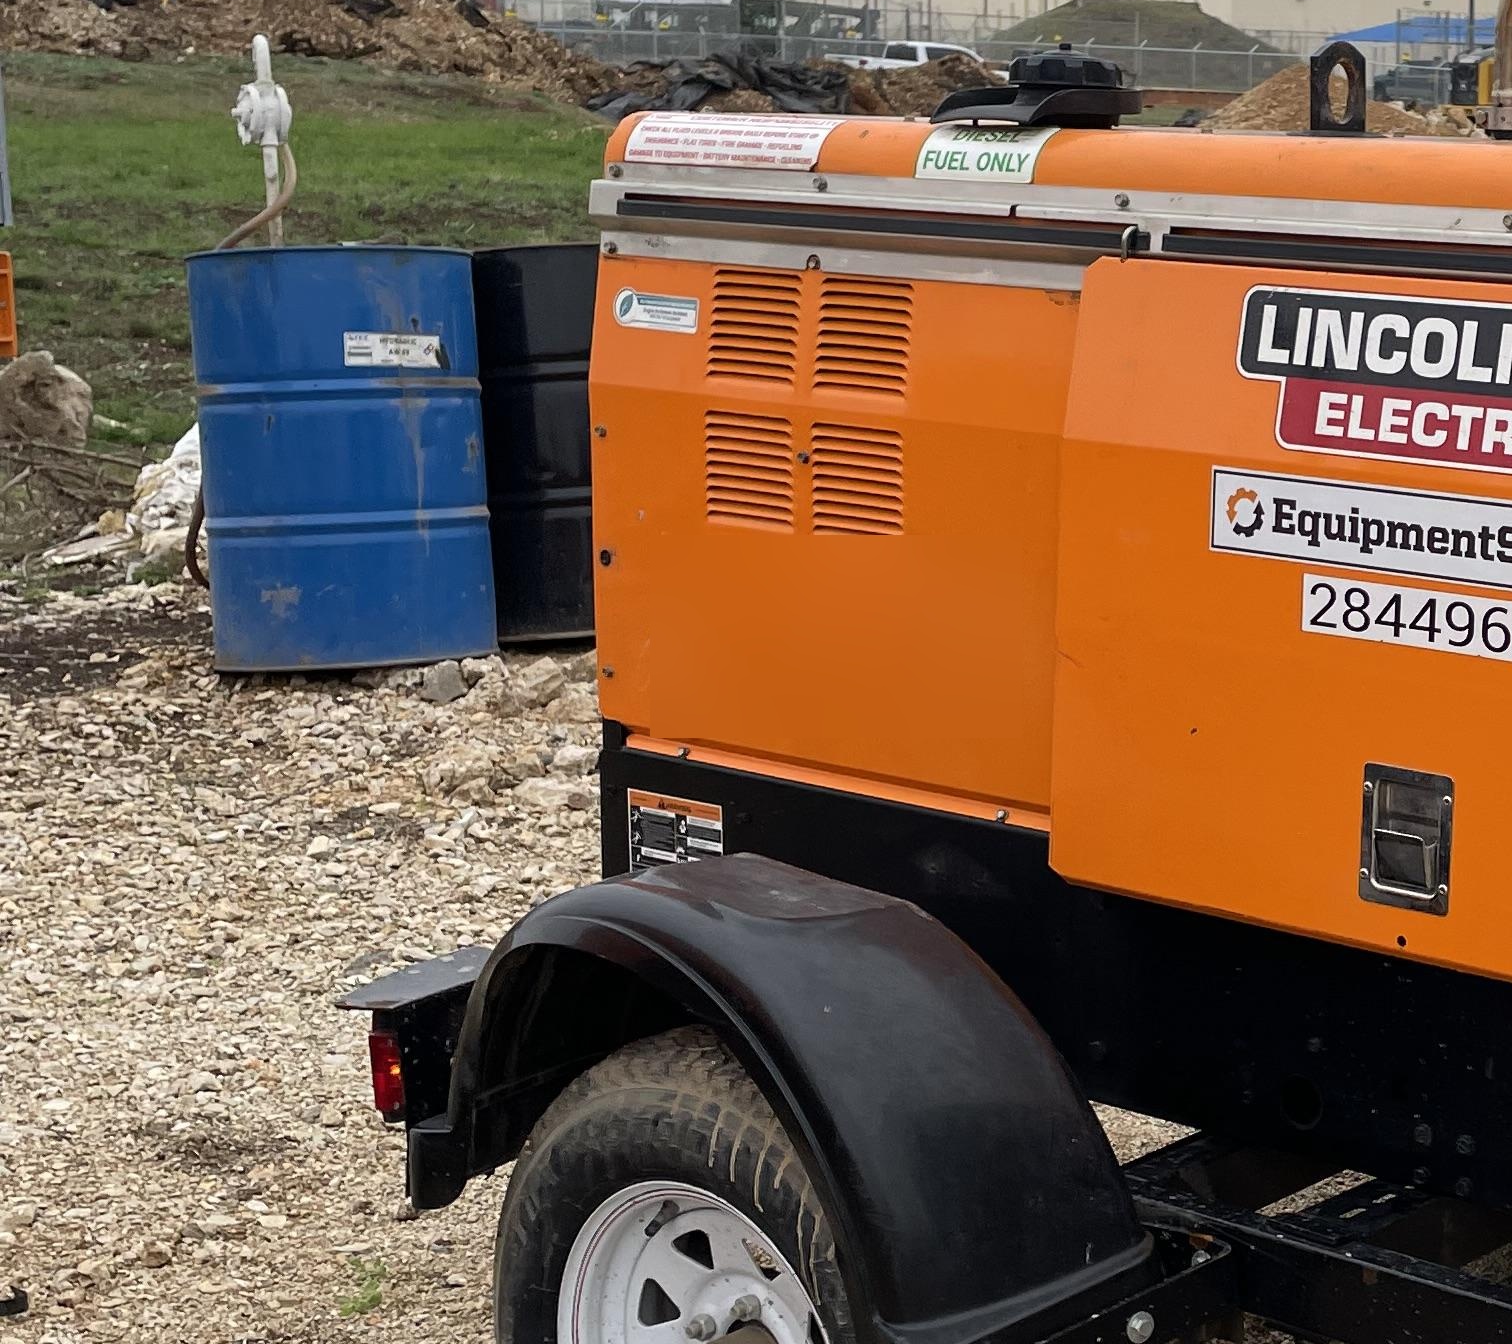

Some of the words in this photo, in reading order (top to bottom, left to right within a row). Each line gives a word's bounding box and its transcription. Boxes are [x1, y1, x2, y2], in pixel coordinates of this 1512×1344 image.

[952, 129, 1020, 143] DIESEL
[923, 150, 969, 170] FUEL
[976, 151, 1030, 173] ONLY
[1309, 582, 1512, 653] 284496
